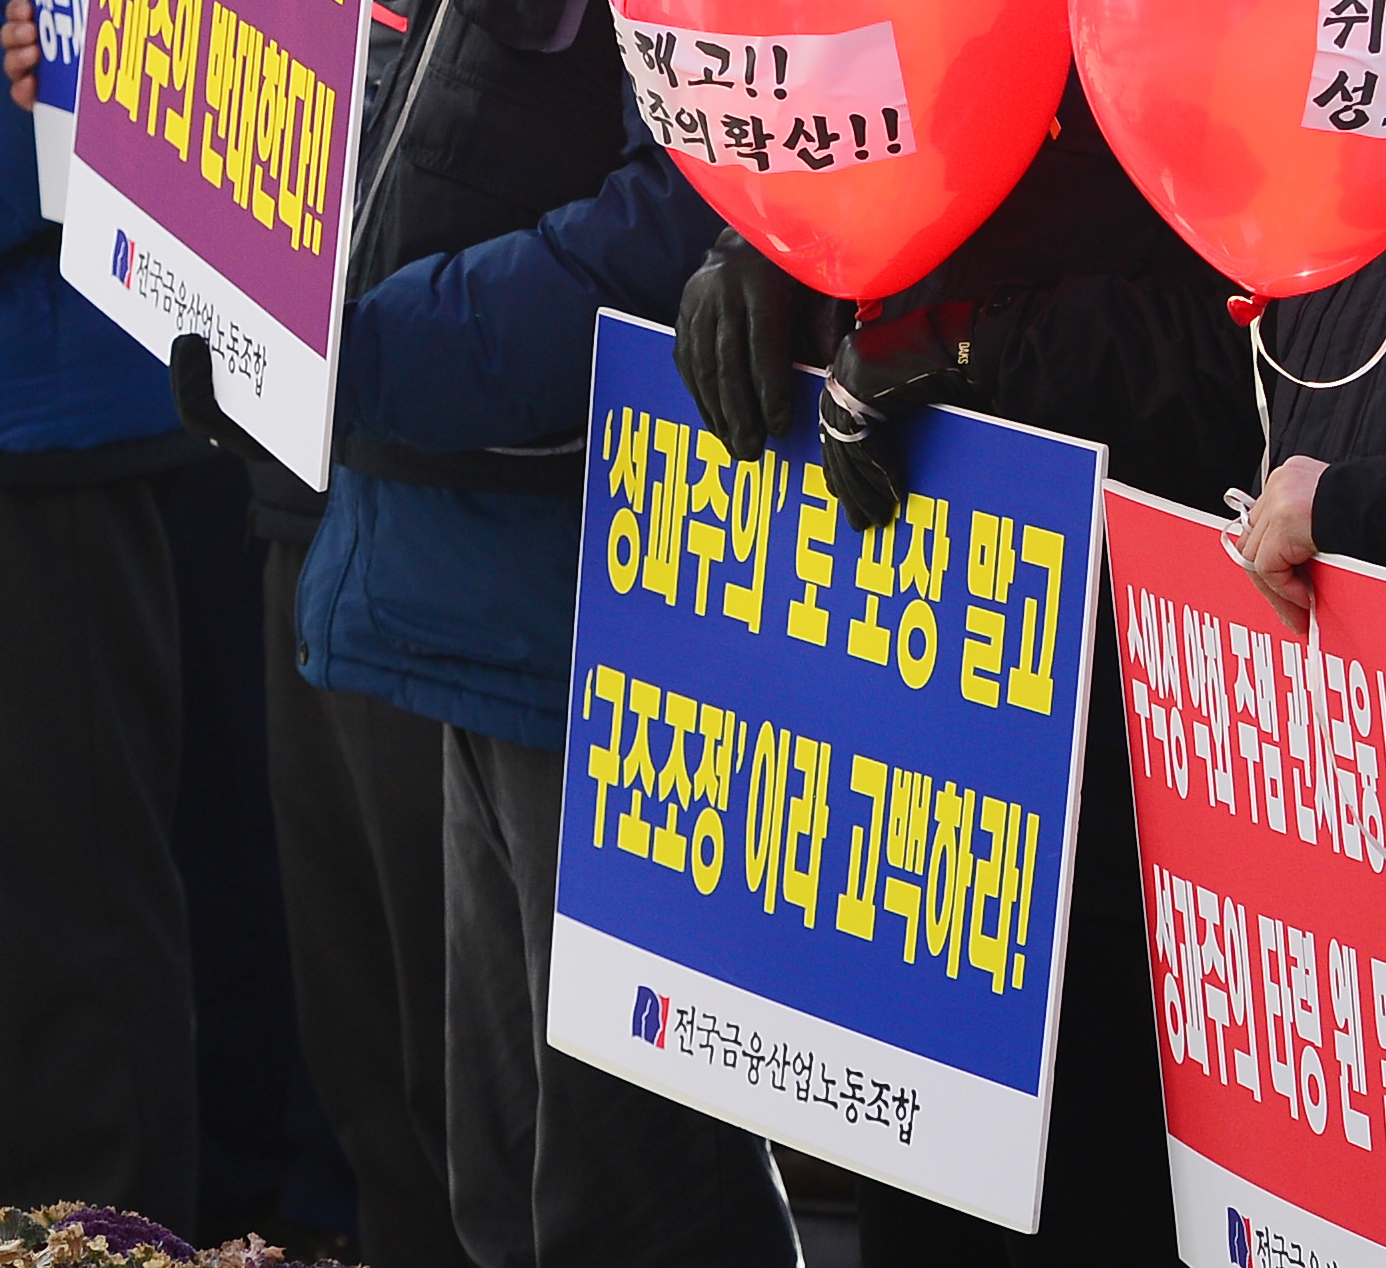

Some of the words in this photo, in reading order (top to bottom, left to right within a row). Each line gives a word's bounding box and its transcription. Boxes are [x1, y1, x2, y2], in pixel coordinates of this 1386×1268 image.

[628, 74, 903, 172] 주의확산!!
[633, 30, 790, 101] 해고!!
[960, 510, 1065, 717] 말고
[1127, 584, 1189, 801] 수익성
[1182, 603, 1237, 816] 악화
[1228, 621, 1288, 835] 주범
[1280, 639, 1385, 874] 관치금융
[835, 753, 1041, 996] 고백하라!
[672, 1004, 921, 1146] 전국금융산업노동조합
[1154, 863, 1262, 1103] 성과주의
[1258, 913, 1329, 1137] 타령
[1327, 936, 1373, 1152] 웬
